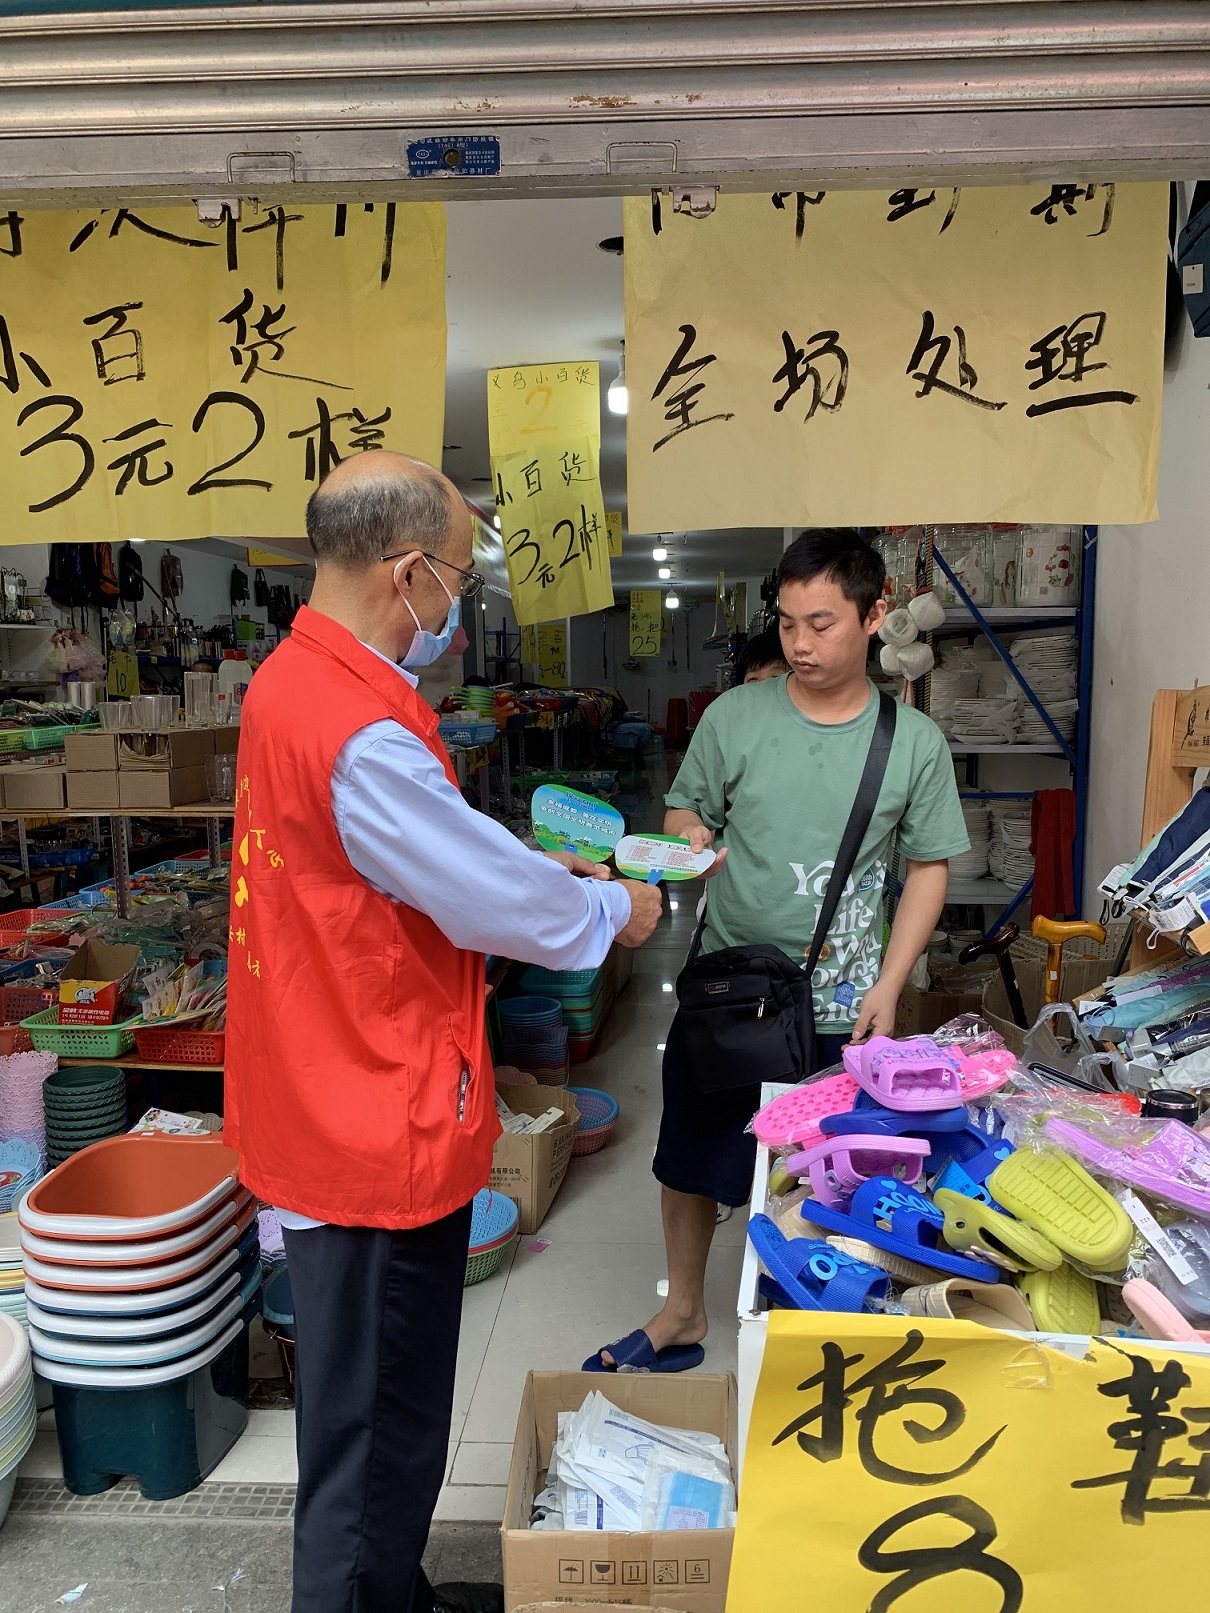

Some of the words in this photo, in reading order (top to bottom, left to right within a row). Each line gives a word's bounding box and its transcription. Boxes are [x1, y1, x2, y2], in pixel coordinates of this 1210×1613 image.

[492, 365, 596, 391] 义乌小百货
[652, 310, 1140, 453] 全场处理
[495, 451, 597, 507] 小百货
[506, 504, 603, 589] 3元2样
